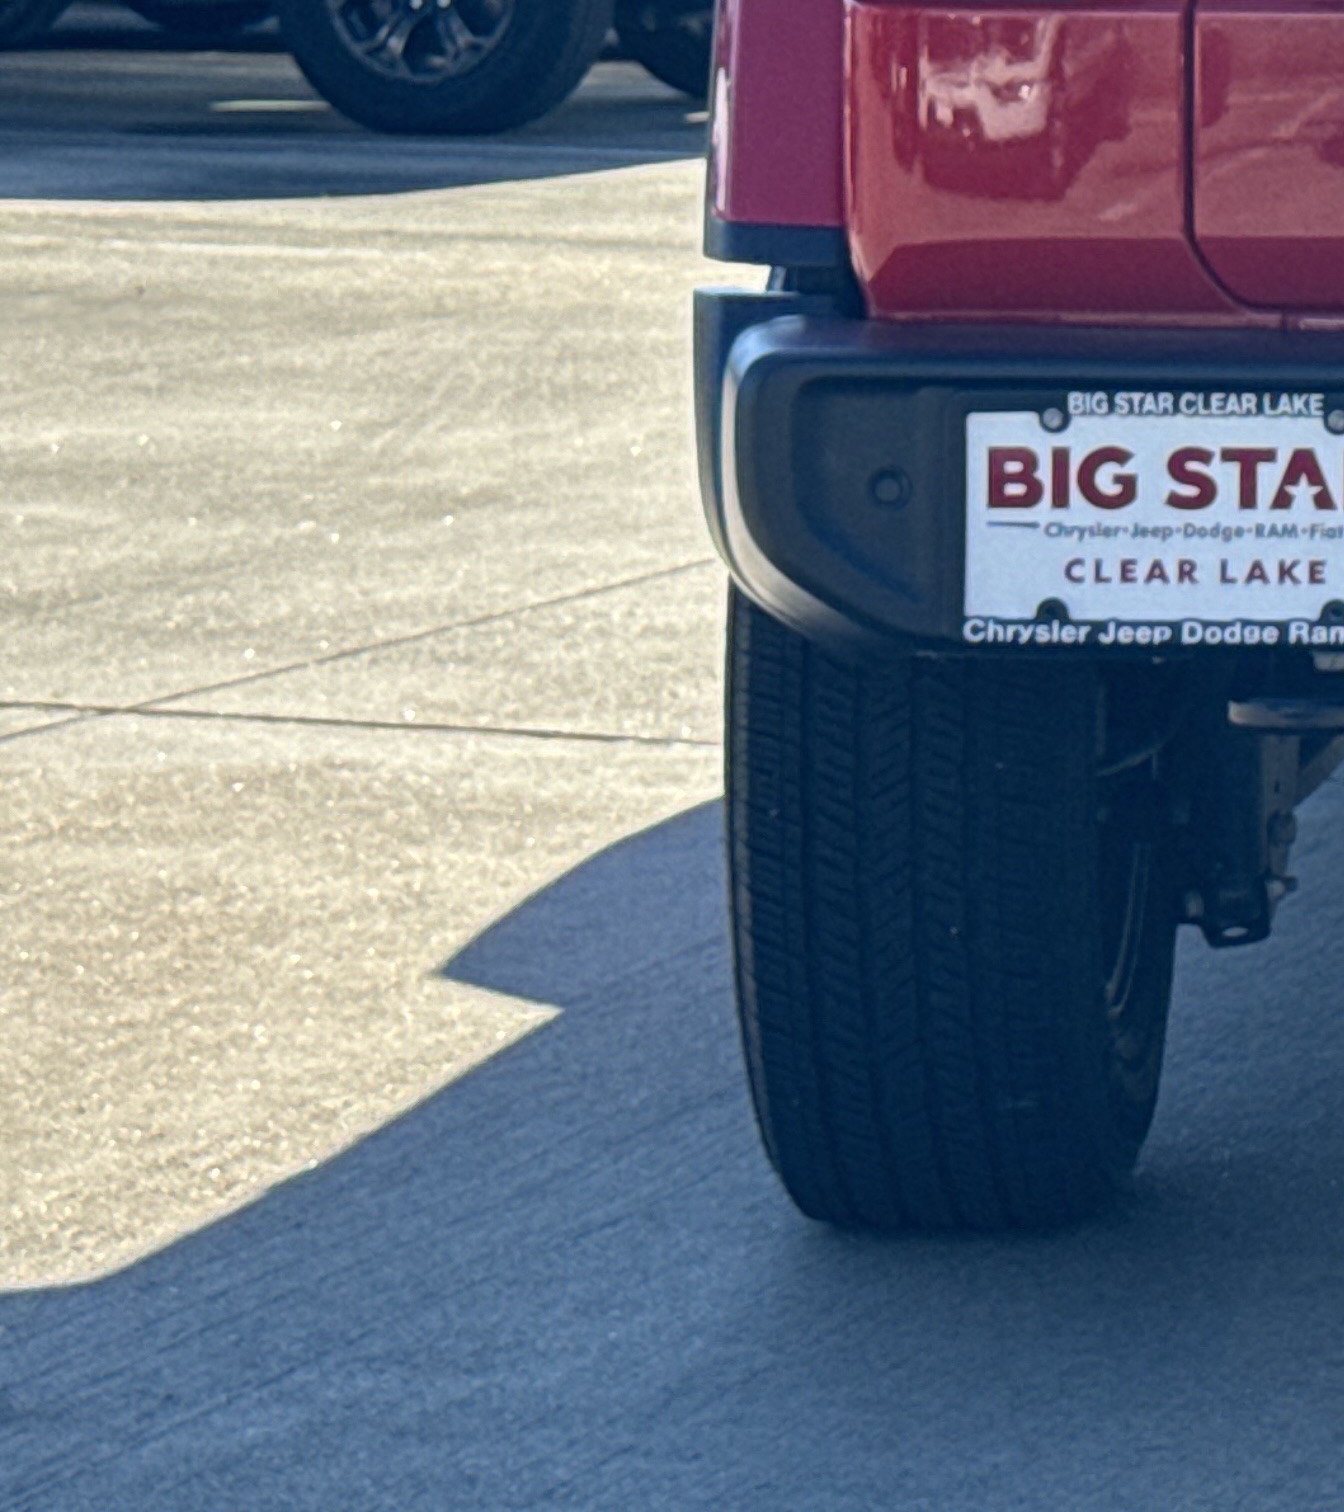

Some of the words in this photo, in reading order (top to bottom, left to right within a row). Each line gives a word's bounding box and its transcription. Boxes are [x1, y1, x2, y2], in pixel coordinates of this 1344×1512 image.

[1067, 392, 1108, 415] BIG
[1114, 392, 1174, 416] STAR
[1179, 393, 1257, 416] CLEAR
[1263, 394, 1324, 417] LAKE
[987, 445, 1138, 511] BIG
[1064, 558, 1199, 584] CLEAR
[1219, 559, 1328, 585] LAKE
[963, 619, 1091, 645] Chrysler
[1098, 621, 1172, 645] Jeep
[1181, 621, 1279, 645] Dodge
